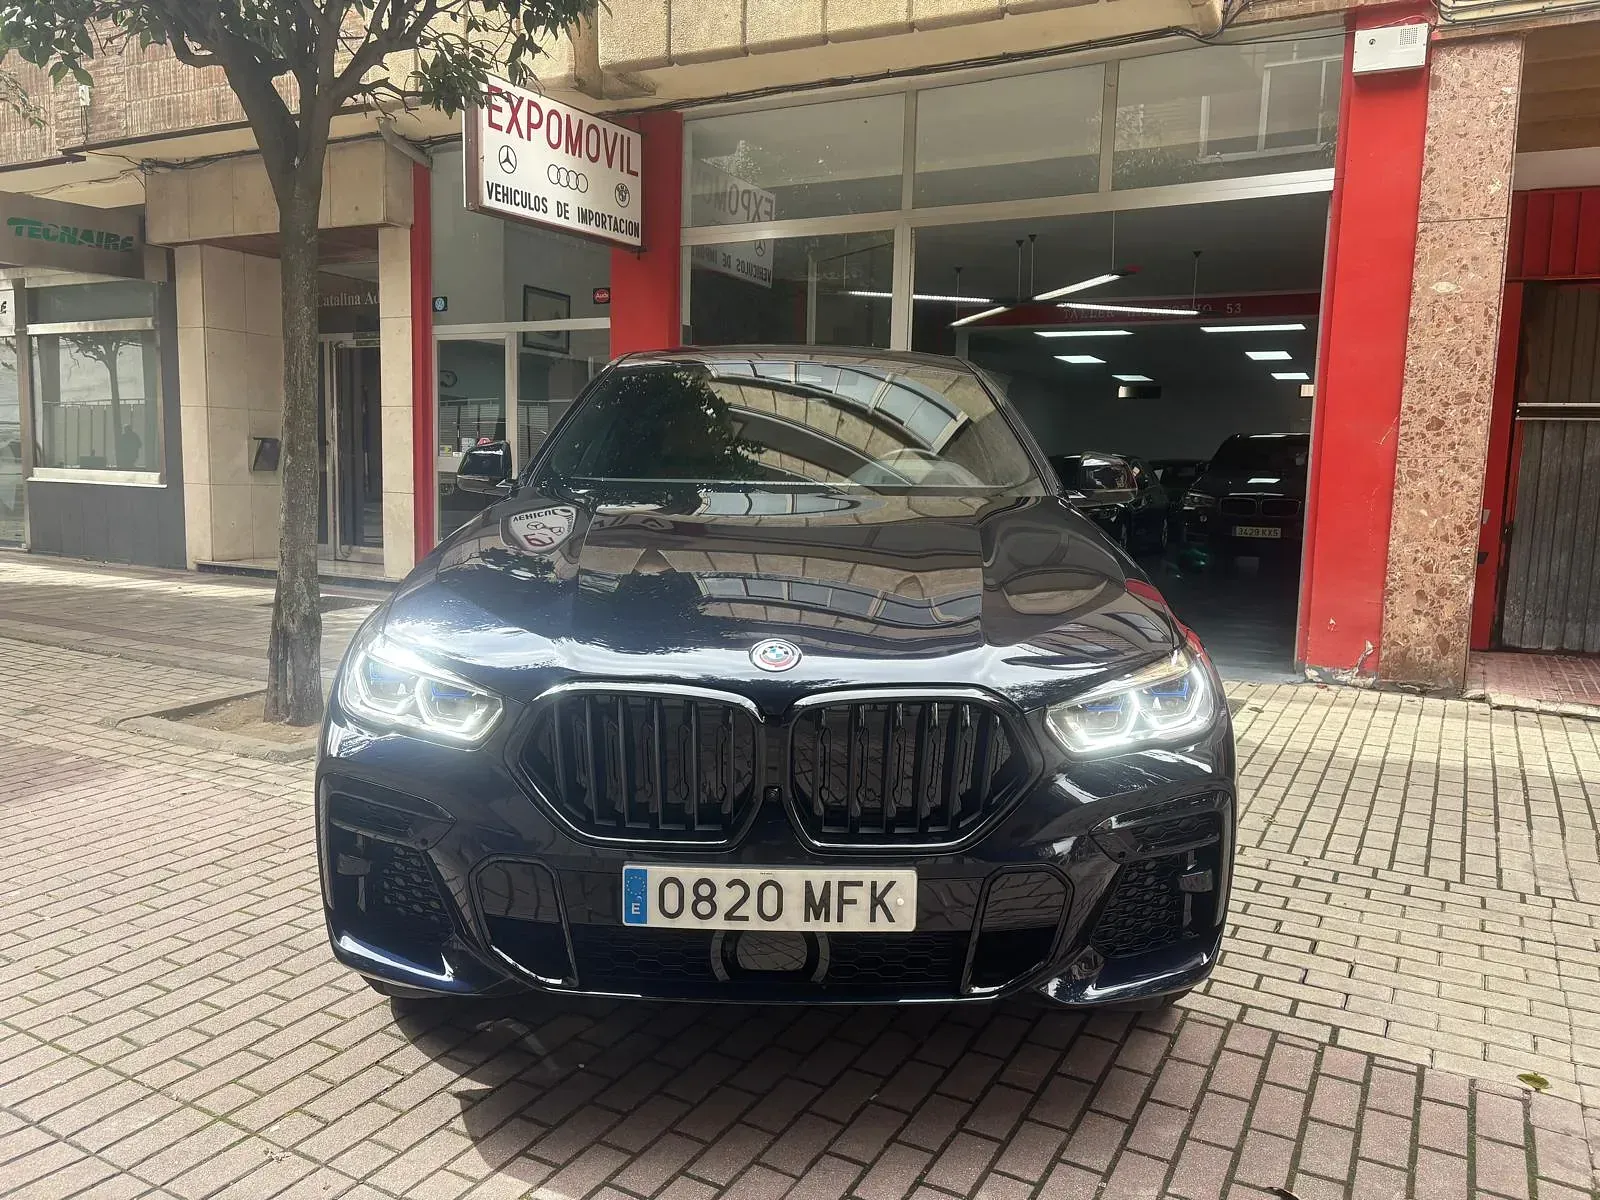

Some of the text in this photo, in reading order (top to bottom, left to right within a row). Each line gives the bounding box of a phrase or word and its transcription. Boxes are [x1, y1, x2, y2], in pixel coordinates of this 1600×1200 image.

[487, 84, 639, 177] EXPOMOVIL
[486, 181, 640, 238] VEHICULOS DE IMPORTACION
[7, 217, 134, 252] TECNAIRE
[1226, 303, 1242, 314] 53
[631, 902, 641, 914] E
[658, 876, 896, 923] 0820 MFK
